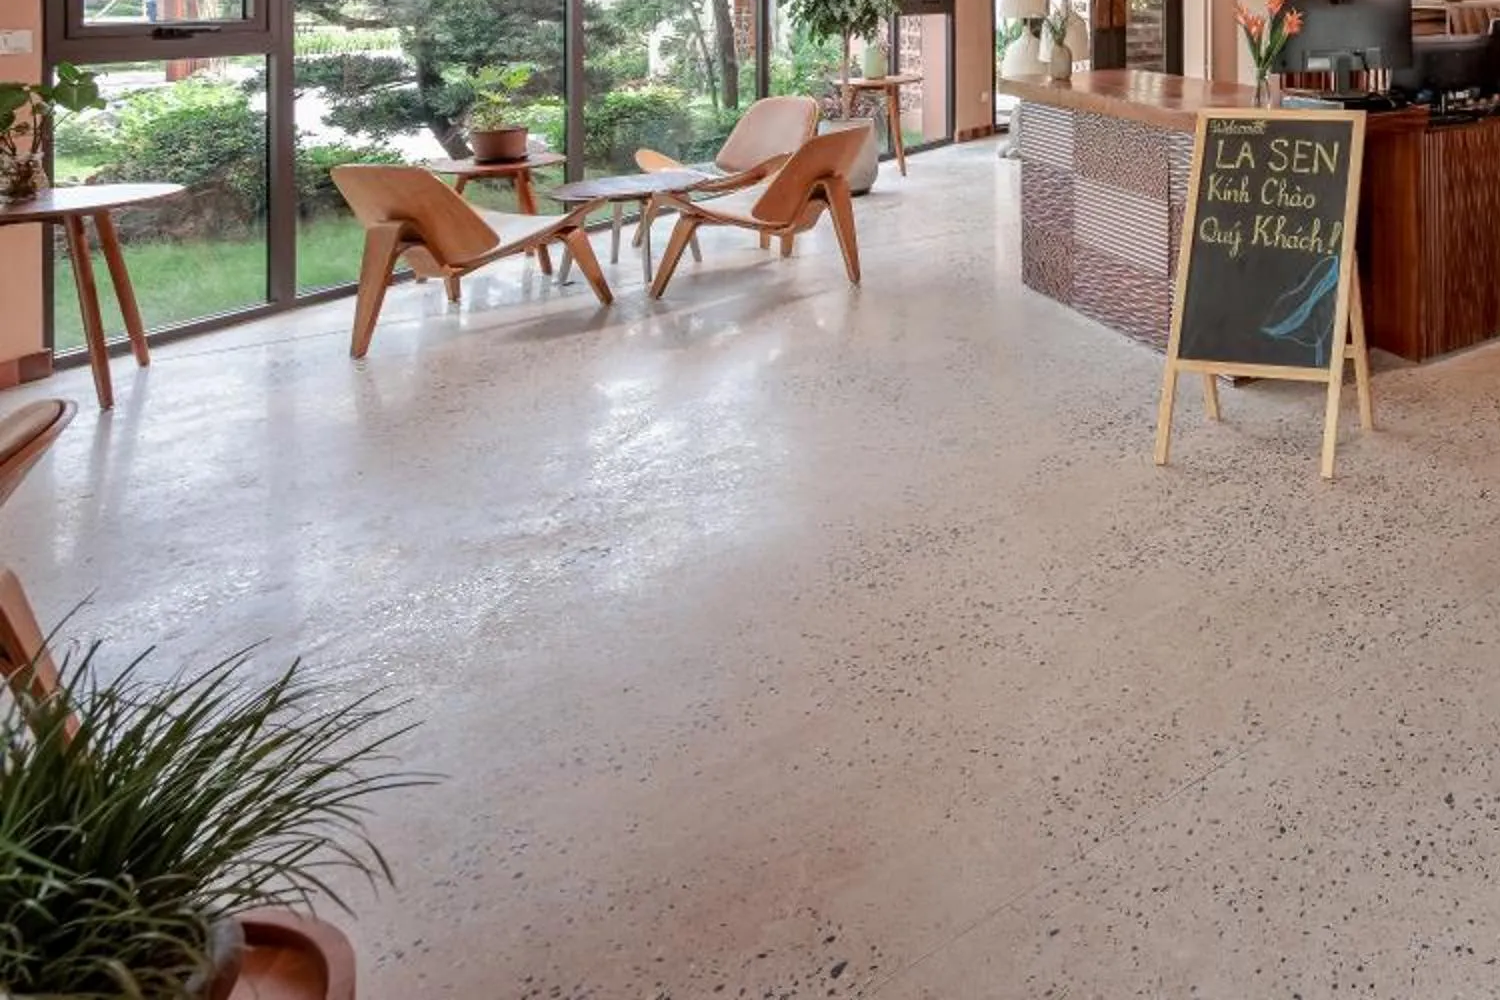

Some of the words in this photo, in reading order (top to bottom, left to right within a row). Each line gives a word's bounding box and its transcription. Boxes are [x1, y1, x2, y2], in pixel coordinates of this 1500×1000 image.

[1215, 139, 1255, 169] LA
[1267, 138, 1340, 174] SEN
[1207, 172, 1250, 203] Kính
[1261, 177, 1316, 209] Chào
[1199, 215, 1242, 259] Quý
[1251, 214, 1344, 255] Khách!
